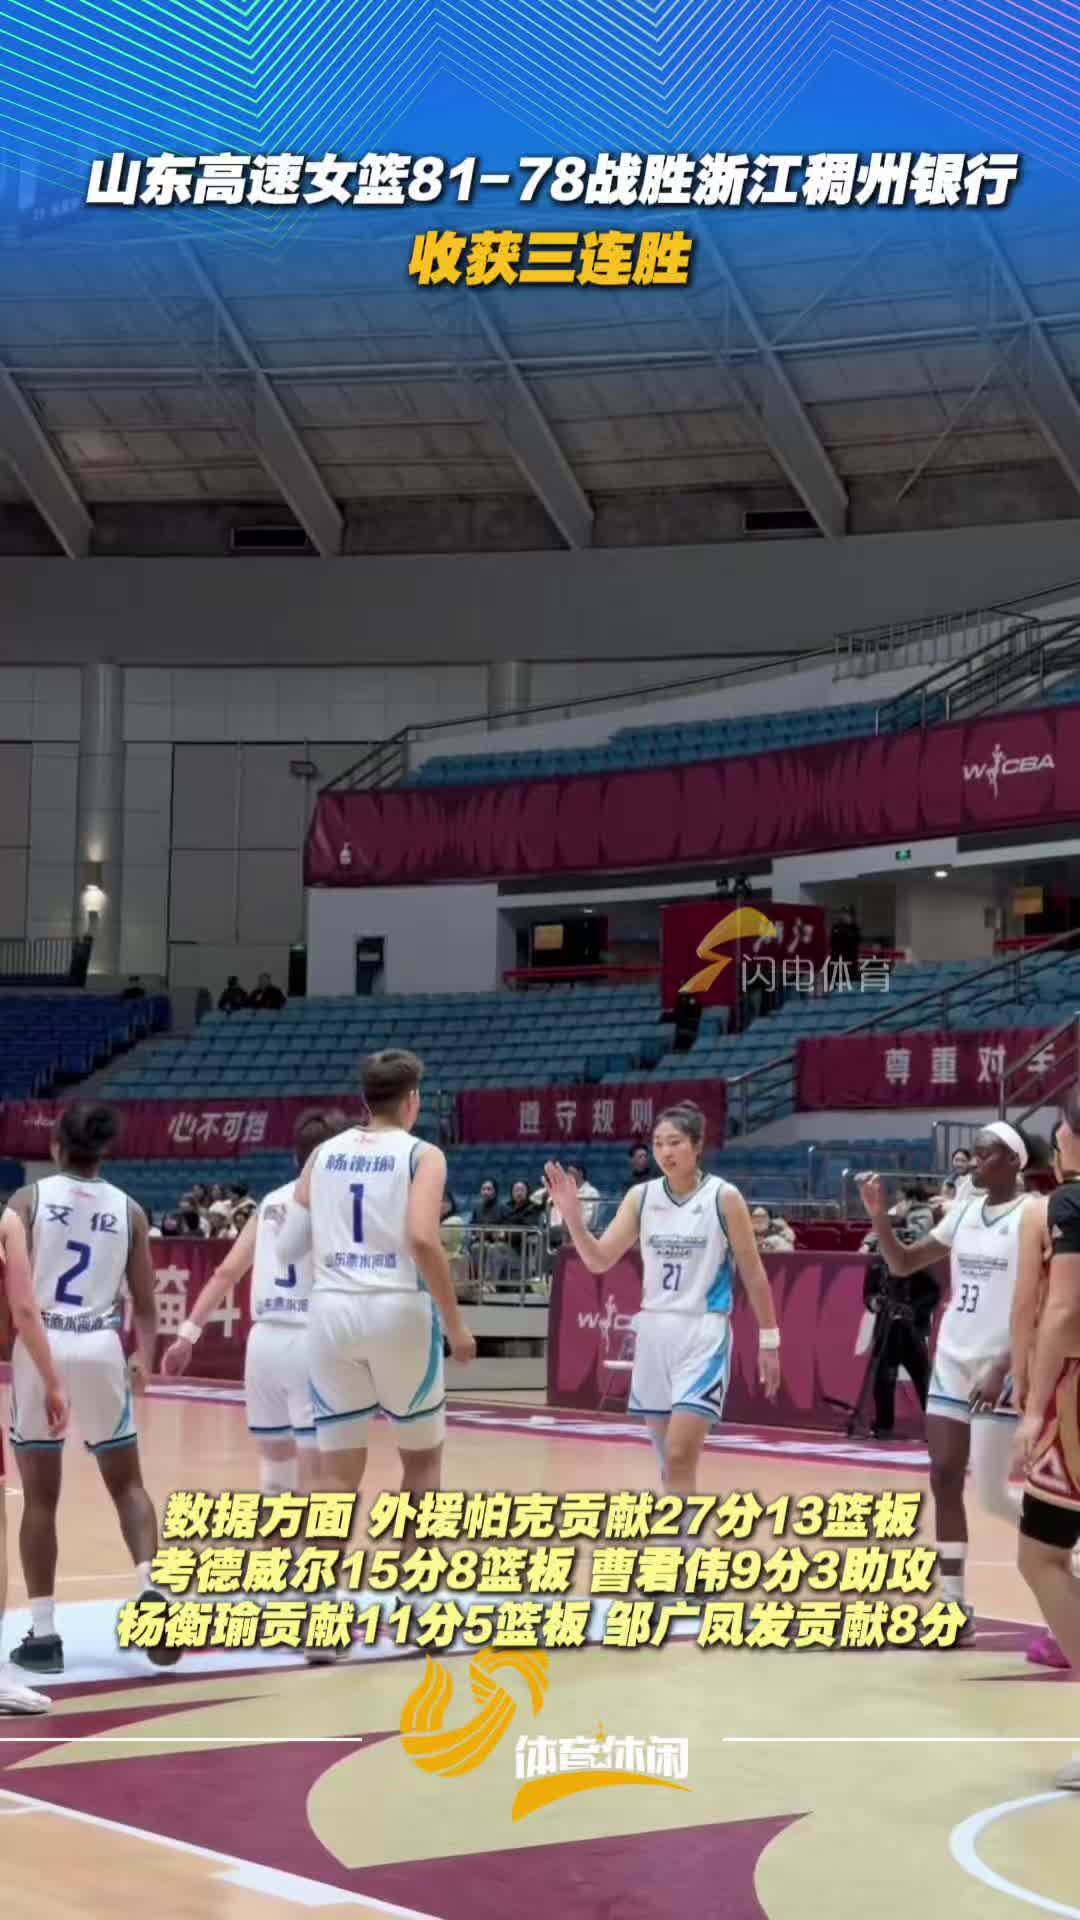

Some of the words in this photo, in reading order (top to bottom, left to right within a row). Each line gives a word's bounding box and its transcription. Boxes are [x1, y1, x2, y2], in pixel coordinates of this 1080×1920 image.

[518, 1098, 653, 1135] 遵守规则
[349, 1183, 364, 1243] 1
[55, 1240, 92, 1306] 2
[662, 1263, 682, 1291] 21
[956, 1283, 980, 1313] 33
